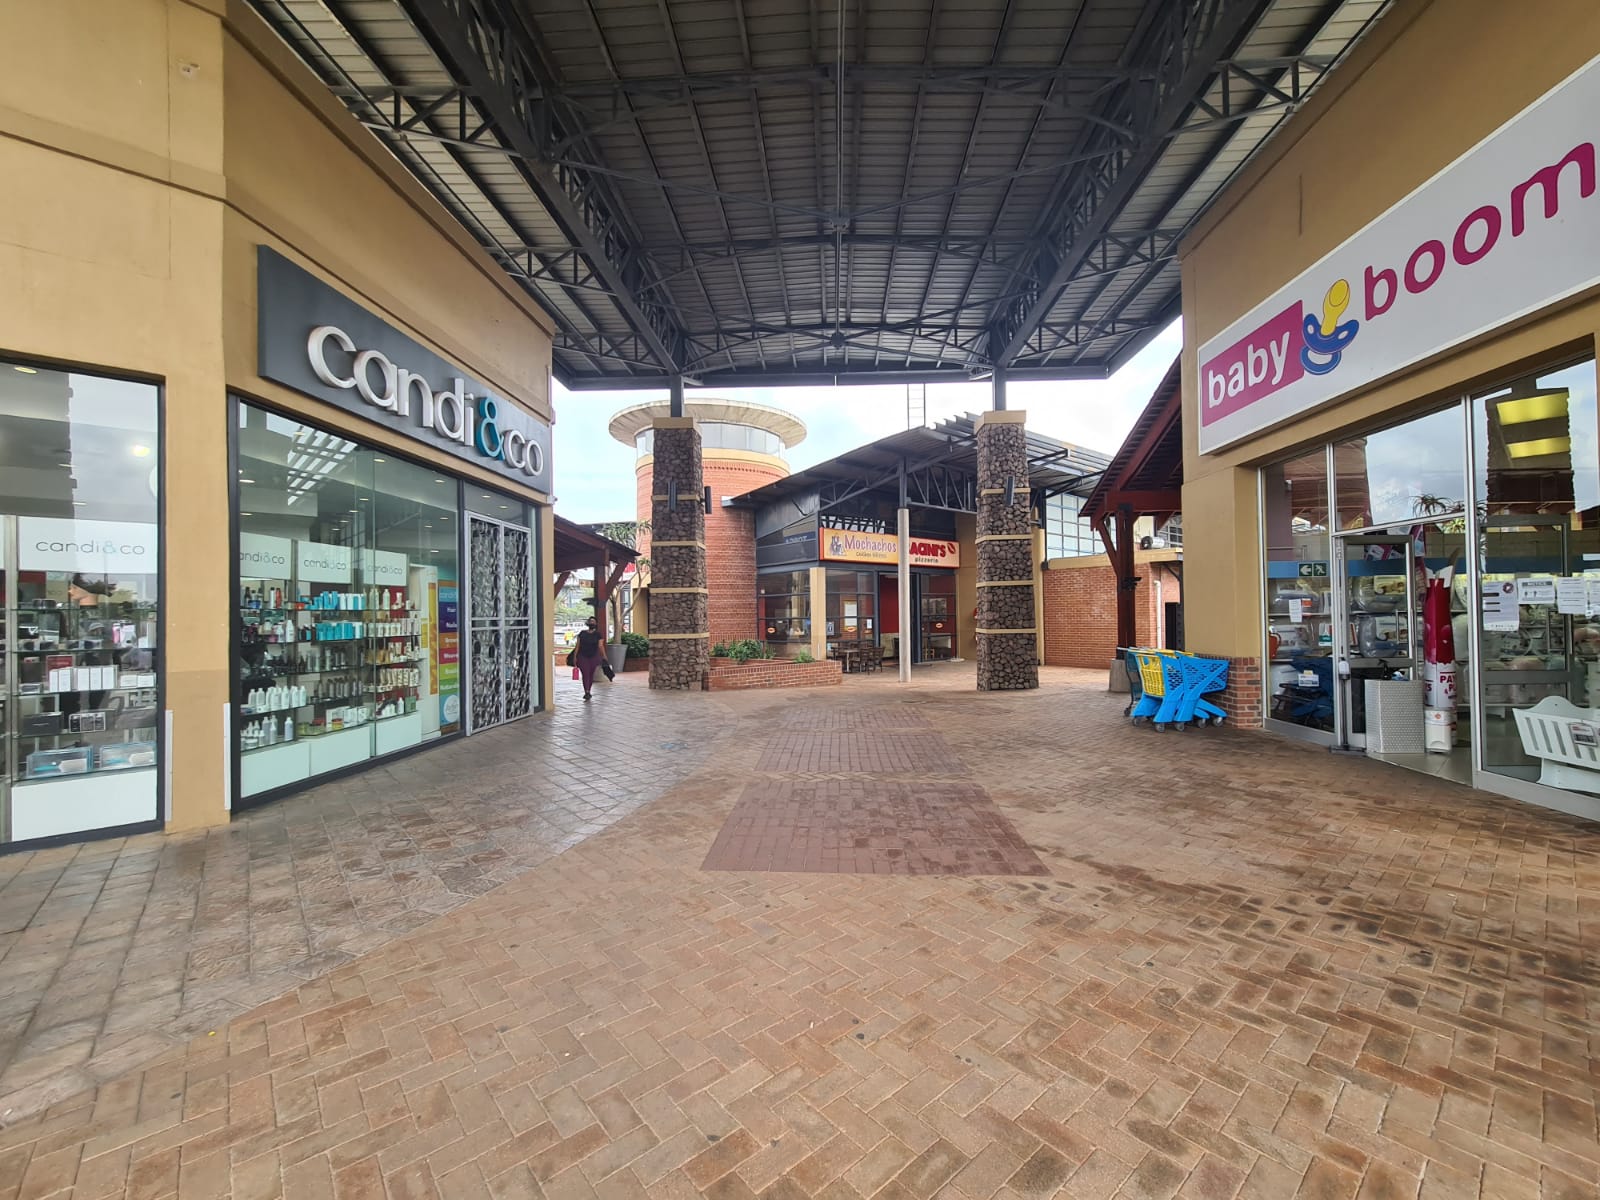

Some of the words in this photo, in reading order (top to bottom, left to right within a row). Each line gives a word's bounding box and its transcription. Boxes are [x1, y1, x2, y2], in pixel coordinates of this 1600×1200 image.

[1208, 331, 1290, 409] baby
[1364, 142, 1596, 321] boom
[307, 325, 544, 477] candi&co
[240, 552, 286, 565] andi&co
[845, 535, 897, 553] Mochachos
